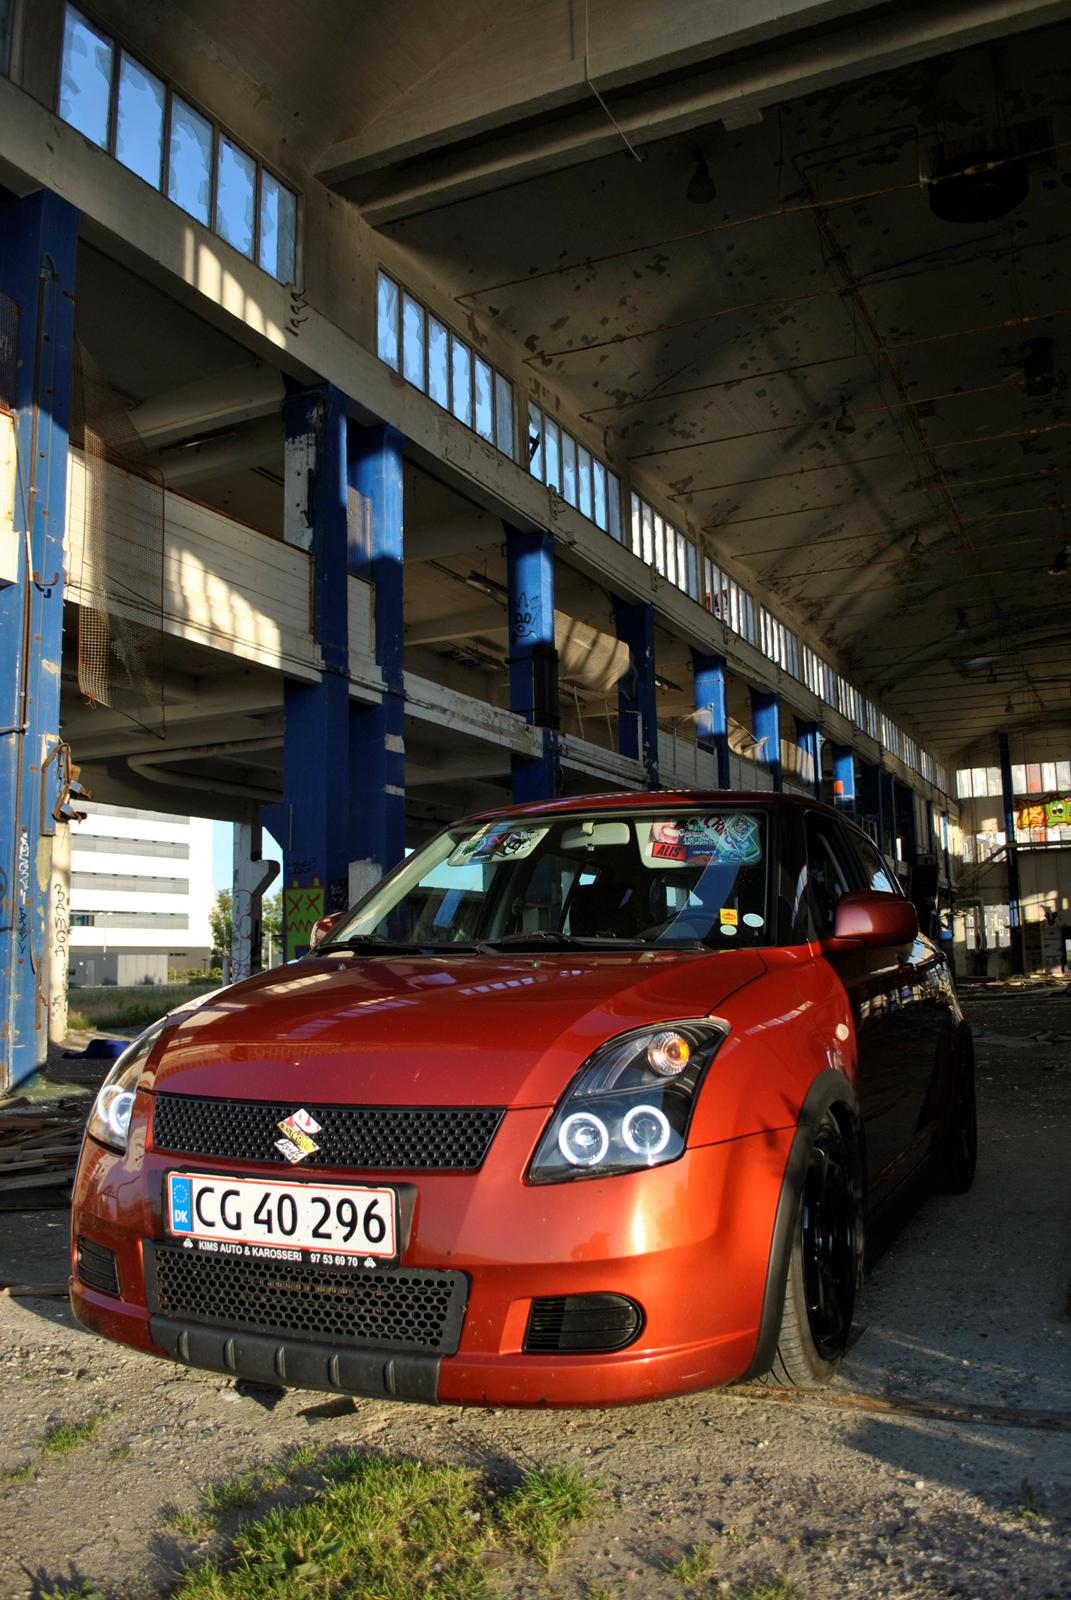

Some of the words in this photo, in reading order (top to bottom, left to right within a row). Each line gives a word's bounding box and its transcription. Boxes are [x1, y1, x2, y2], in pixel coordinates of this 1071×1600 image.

[656, 844, 680, 858] ALIS
[174, 1209, 189, 1223] DK
[195, 1186, 242, 1231] CG
[253, 1191, 298, 1236] 40
[310, 1196, 386, 1243] 296
[198, 1240, 219, 1252] KIMS
[220, 1242, 243, 1255] AUTO
[244, 1245, 251, 1256] &
[252, 1246, 302, 1262] KAROSSERI
[310, 1253, 322, 1263] 97
[323, 1254, 333, 1265] 53
[334, 1255, 346, 1266] 69
[347, 1256, 358, 1267] 70
